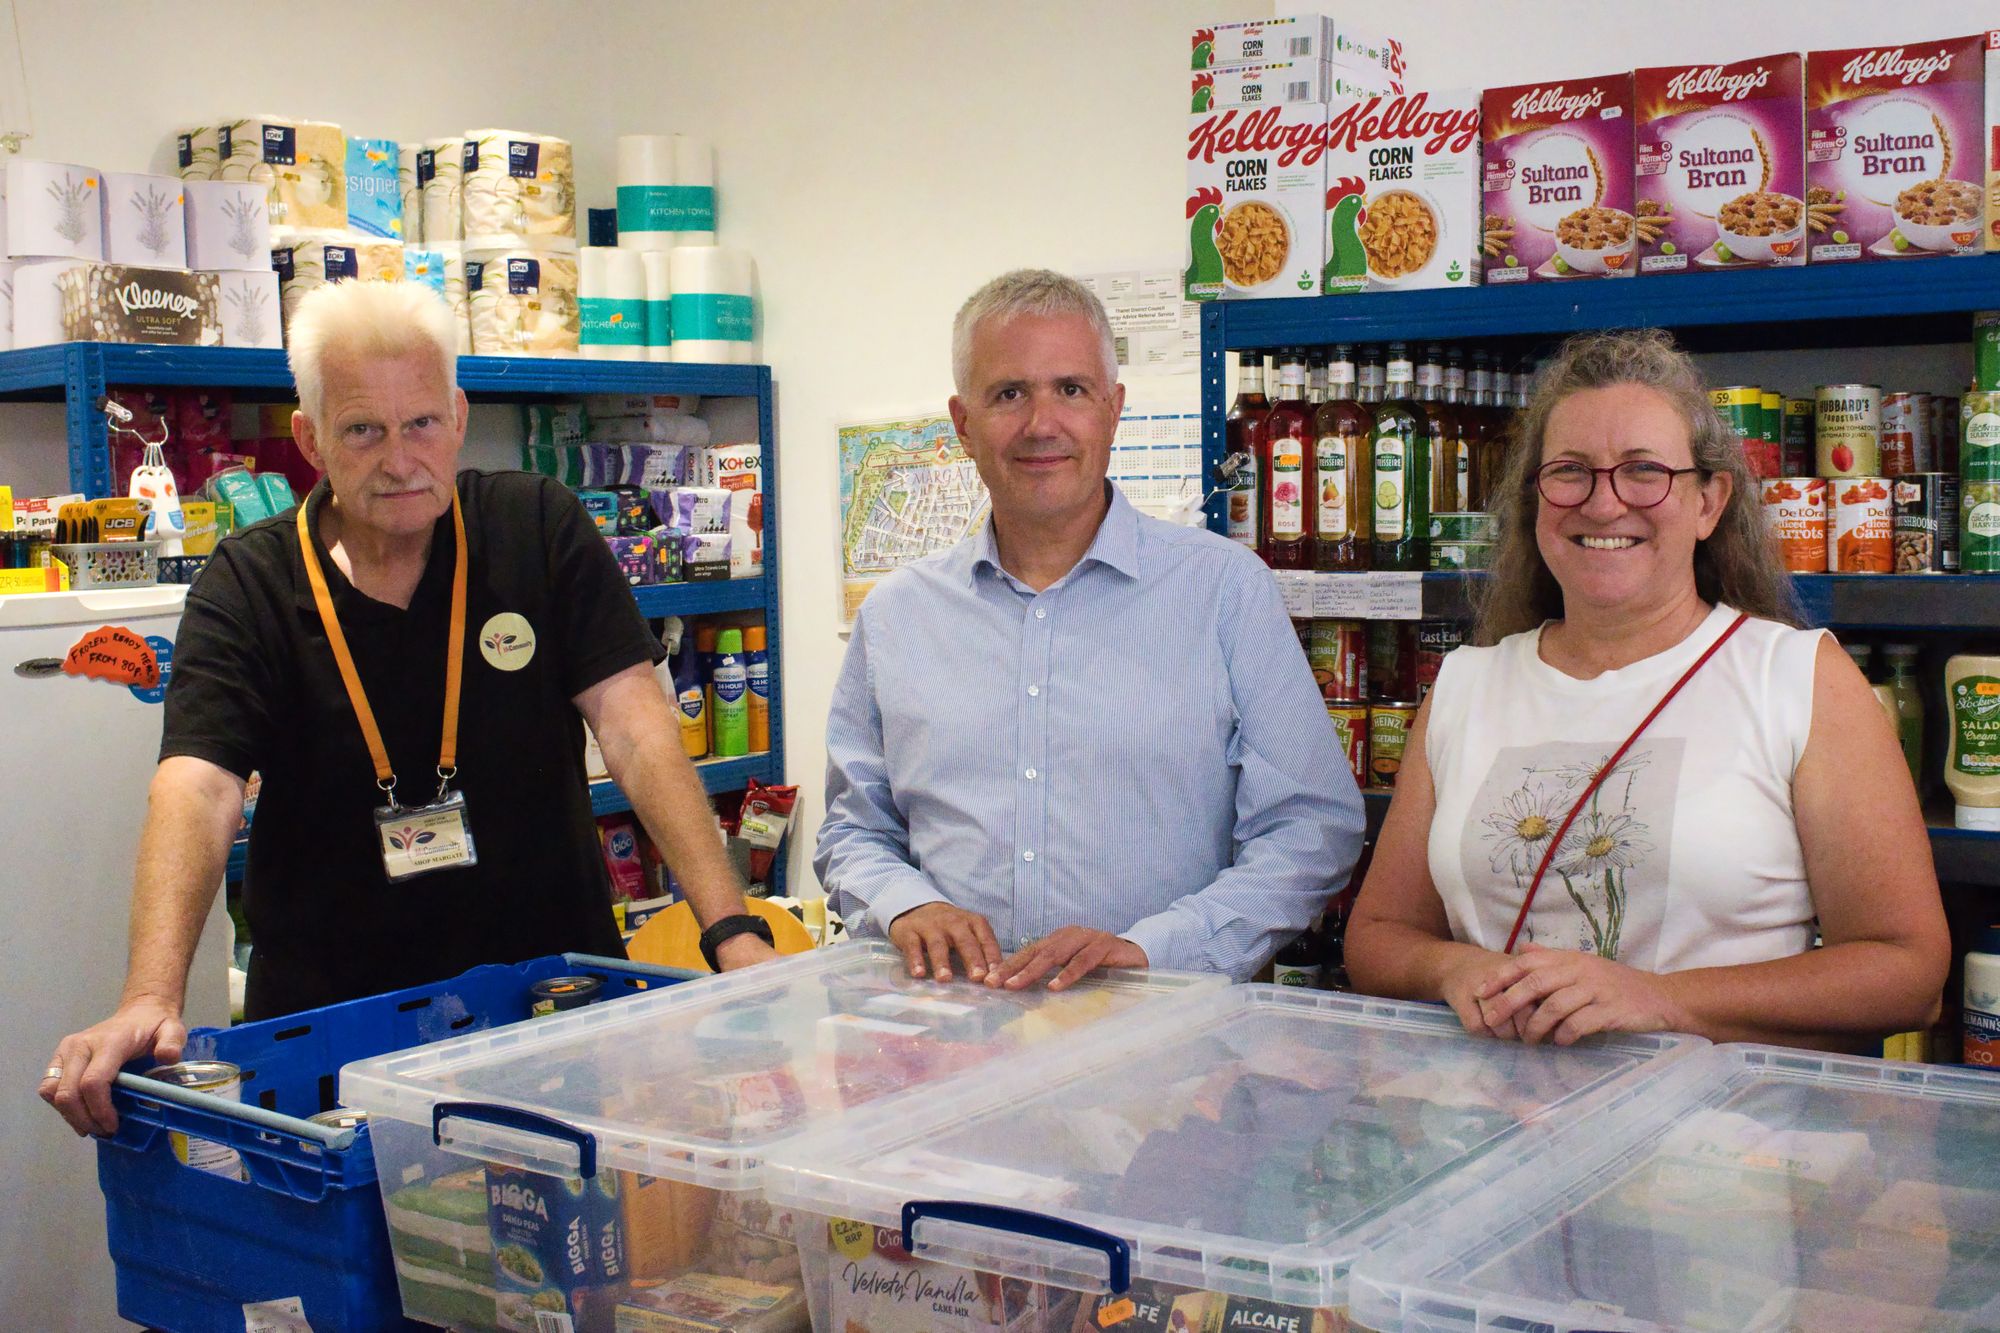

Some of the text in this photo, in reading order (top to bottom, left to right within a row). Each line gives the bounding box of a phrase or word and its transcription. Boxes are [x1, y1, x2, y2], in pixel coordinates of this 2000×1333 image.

[1242, 40, 1263, 51] CORN
[1242, 49, 1263, 58] FLAKES
[1842, 48, 1956, 85] Kellogg's
[1241, 84, 1262, 95] CORN
[1667, 66, 1772, 101] Kellogg's
[1241, 93, 1262, 102] FLAKES
[1512, 86, 1606, 120] Kellogg's
[266, 131, 282, 140] TORK
[1854, 132, 1934, 153] Sultana
[1369, 147, 1413, 167] CORN
[1679, 148, 1754, 168] Sultana
[1226, 159, 1267, 178] CORN
[1862, 155, 1926, 176] Bran
[1369, 165, 1412, 181] FLAKES
[1521, 165, 1589, 184] Sultana
[1687, 169, 1747, 189] Bran
[1226, 177, 1267, 192] FLAKES
[1528, 185, 1582, 204] Bran
[650, 207, 685, 216] KITCHEN
[327, 253, 344, 261] TORK
[115, 282, 199, 319] Kleenex
[136, 315, 182, 325] ULTRA SOFT
[581, 321, 617, 330] KITCHEN
[693, 496, 709, 504] Ultra
[1780, 507, 1796, 517] De
[1867, 507, 1884, 517] De
[105, 518, 136, 529] JCB
[1778, 519, 1807, 529] diced
[1866, 519, 1891, 529] diced
[1777, 528, 1824, 540] arrots
[1420, 631, 1463, 643] East End
[71, 636, 109, 664] FROZEN
[112, 632, 141, 650] READY
[89, 652, 117, 666] FROM
[1374, 717, 1401, 729] HEINZ
[1961, 720, 2000, 730] SALAD
[1964, 730, 1998, 740] Cream
[612, 835, 632, 853] bloo
[491, 1183, 549, 1223] BIGGA
[523, 1219, 540, 1232] PEAS
[567, 1215, 585, 1275] BIGGA
[844, 1231, 863, 1245] RRP
[601, 1219, 620, 1277] BIGGA
[842, 1261, 980, 1304] Velvety Vanilla
[932, 1302, 970, 1317] CAKE MIX
[1230, 1308, 1301, 1333] ALCAFÉ
